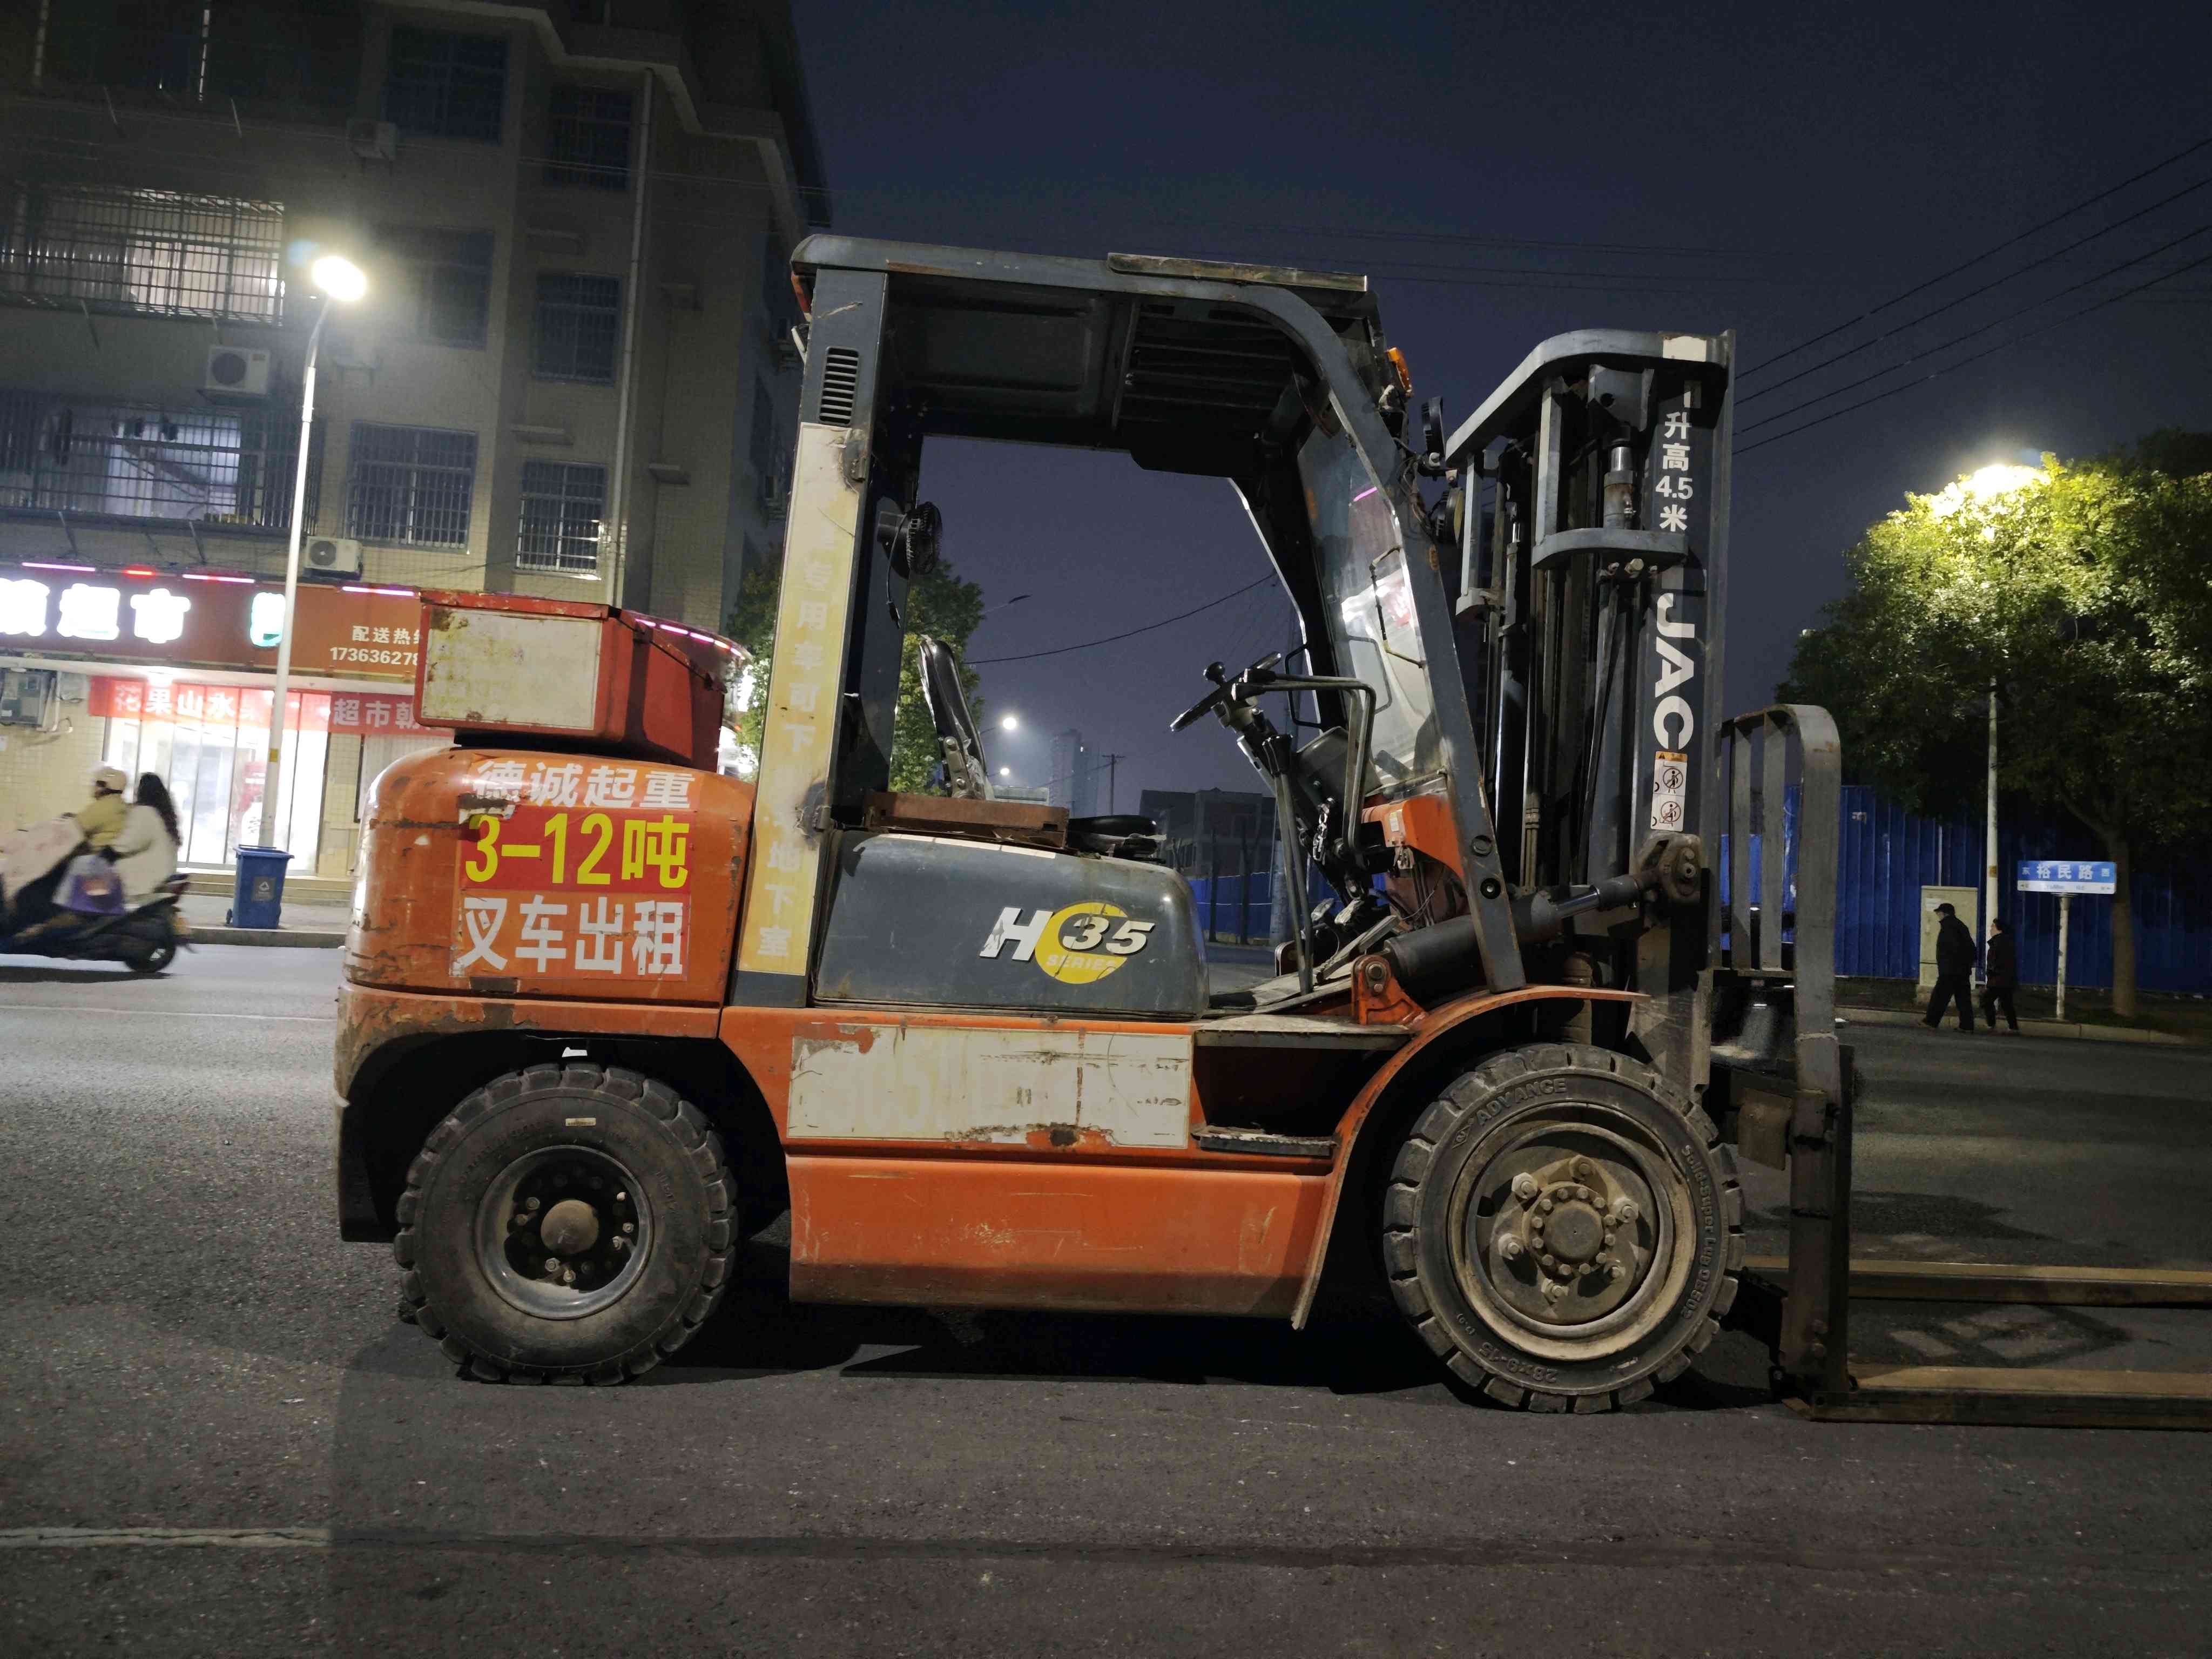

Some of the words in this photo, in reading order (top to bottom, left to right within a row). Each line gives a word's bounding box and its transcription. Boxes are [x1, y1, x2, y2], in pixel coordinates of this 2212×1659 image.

[1655, 412, 1693, 532] 升高4.5米
[1654, 593, 1695, 750] JAC
[472, 760, 695, 808] 德诚起重
[2036, 864, 2093, 880] 裕民路
[453, 894, 683, 975] 叉车出租
[1476, 1078, 1567, 1125] ADVANCE
